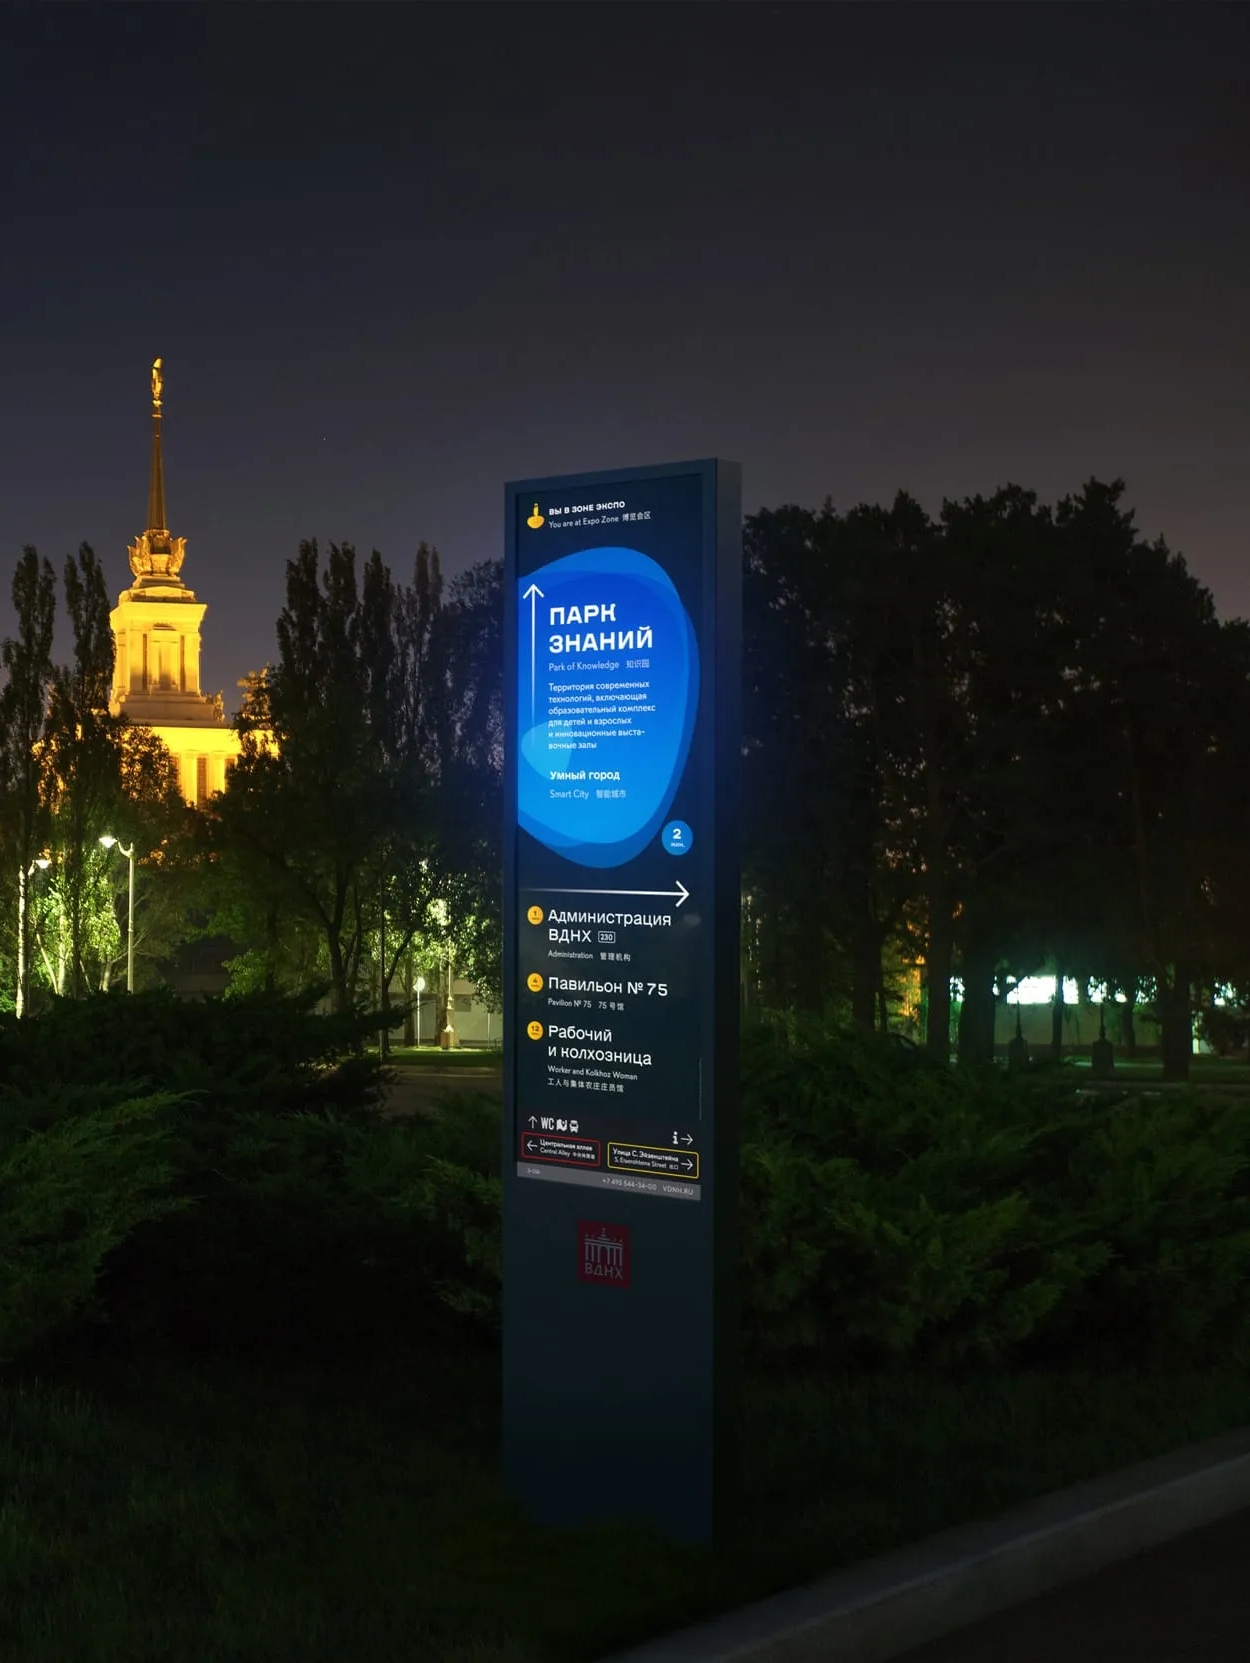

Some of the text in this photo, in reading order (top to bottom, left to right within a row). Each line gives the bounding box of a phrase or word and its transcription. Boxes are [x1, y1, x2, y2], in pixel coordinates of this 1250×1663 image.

[549, 501, 626, 516] ВЫ В ЗОНЕ ЭКСПО
[549, 520, 561, 529] You
[583, 517, 600, 527] Expo
[601, 515, 619, 524] Zone
[550, 603, 616, 625] ПАРК
[549, 625, 653, 654] ЗНАНИЙ
[549, 663, 565, 671] Park
[567, 662, 575, 670] of
[577, 660, 620, 670] Knowledge
[548, 681, 650, 693] Территория современных
[549, 693, 647, 703] технологий, включающая
[548, 704, 656, 716] образовательный комплекс
[548, 719, 562, 728] для
[563, 718, 586, 727] детей
[594, 718, 632, 726] взрослых
[555, 730, 616, 738] инновационные
[550, 770, 621, 782] Умный город
[550, 789, 571, 798] Smart
[573, 789, 590, 800] City
[673, 828, 682, 840] 2
[548, 909, 671, 928] Администрация
[549, 928, 592, 944] ВДНХ
[548, 950, 594, 960] Administration
[548, 977, 623, 994] Павильон
[647, 983, 668, 997] 75
[548, 1025, 613, 1043] Рабочий
[548, 1046, 652, 1067] и колхозница
[547, 1064, 638, 1081] Worker and Kolkhoz Woman
[540, 1116, 554, 1131] WC
[540, 1147, 557, 1155] Central
[584, 1261, 624, 1280] ВДНХ
